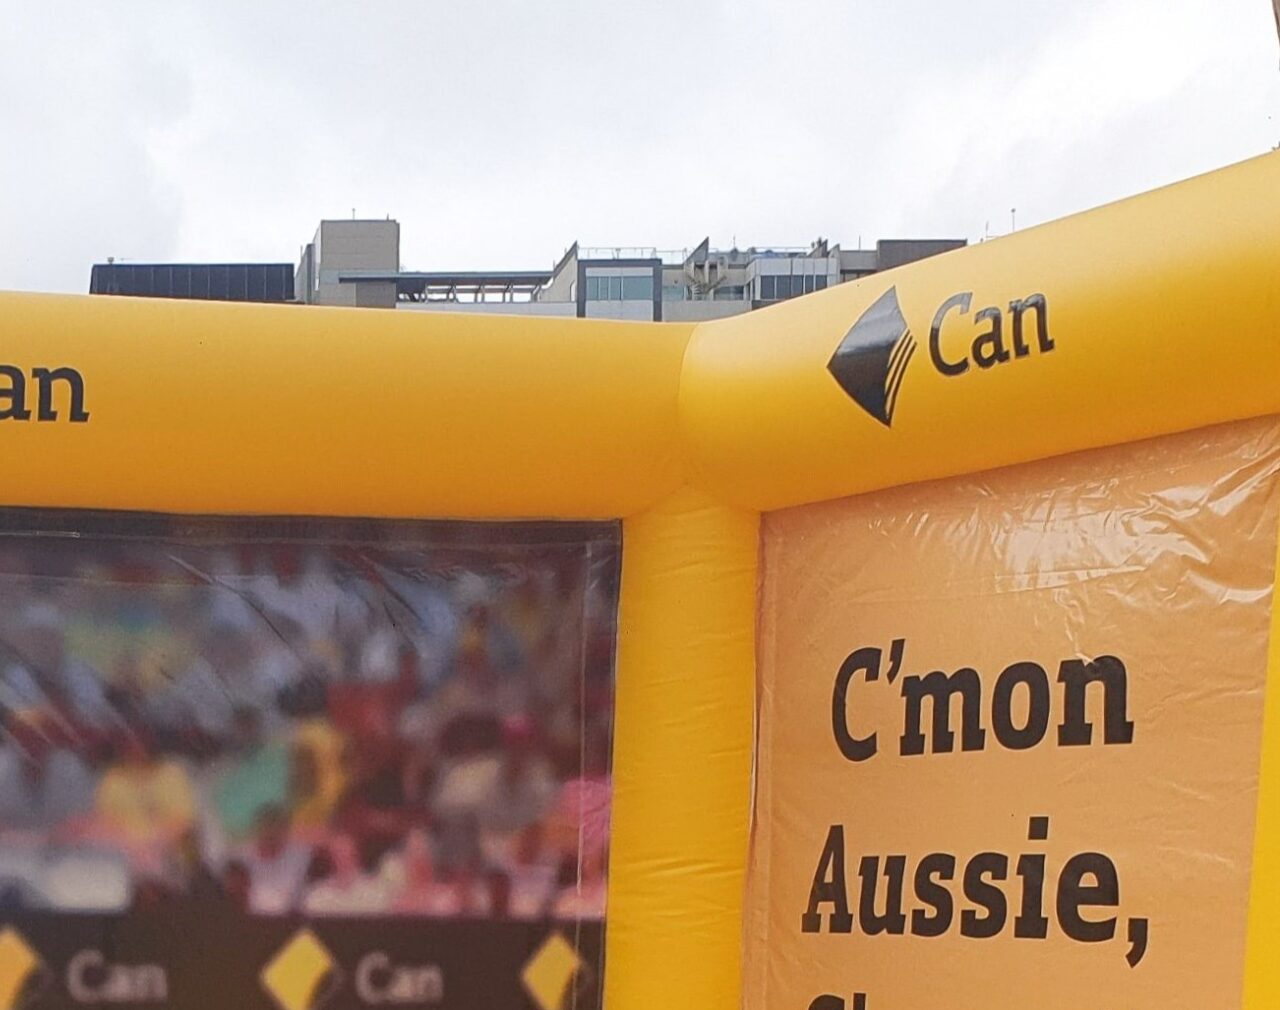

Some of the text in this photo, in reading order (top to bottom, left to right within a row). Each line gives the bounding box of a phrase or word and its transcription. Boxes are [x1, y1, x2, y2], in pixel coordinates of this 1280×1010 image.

[928, 291, 1055, 376] Can
[832, 638, 1135, 762] C'mon
[801, 816, 1149, 969] Aussie,
[66, 950, 168, 999] Can
[355, 953, 443, 1001] Can
